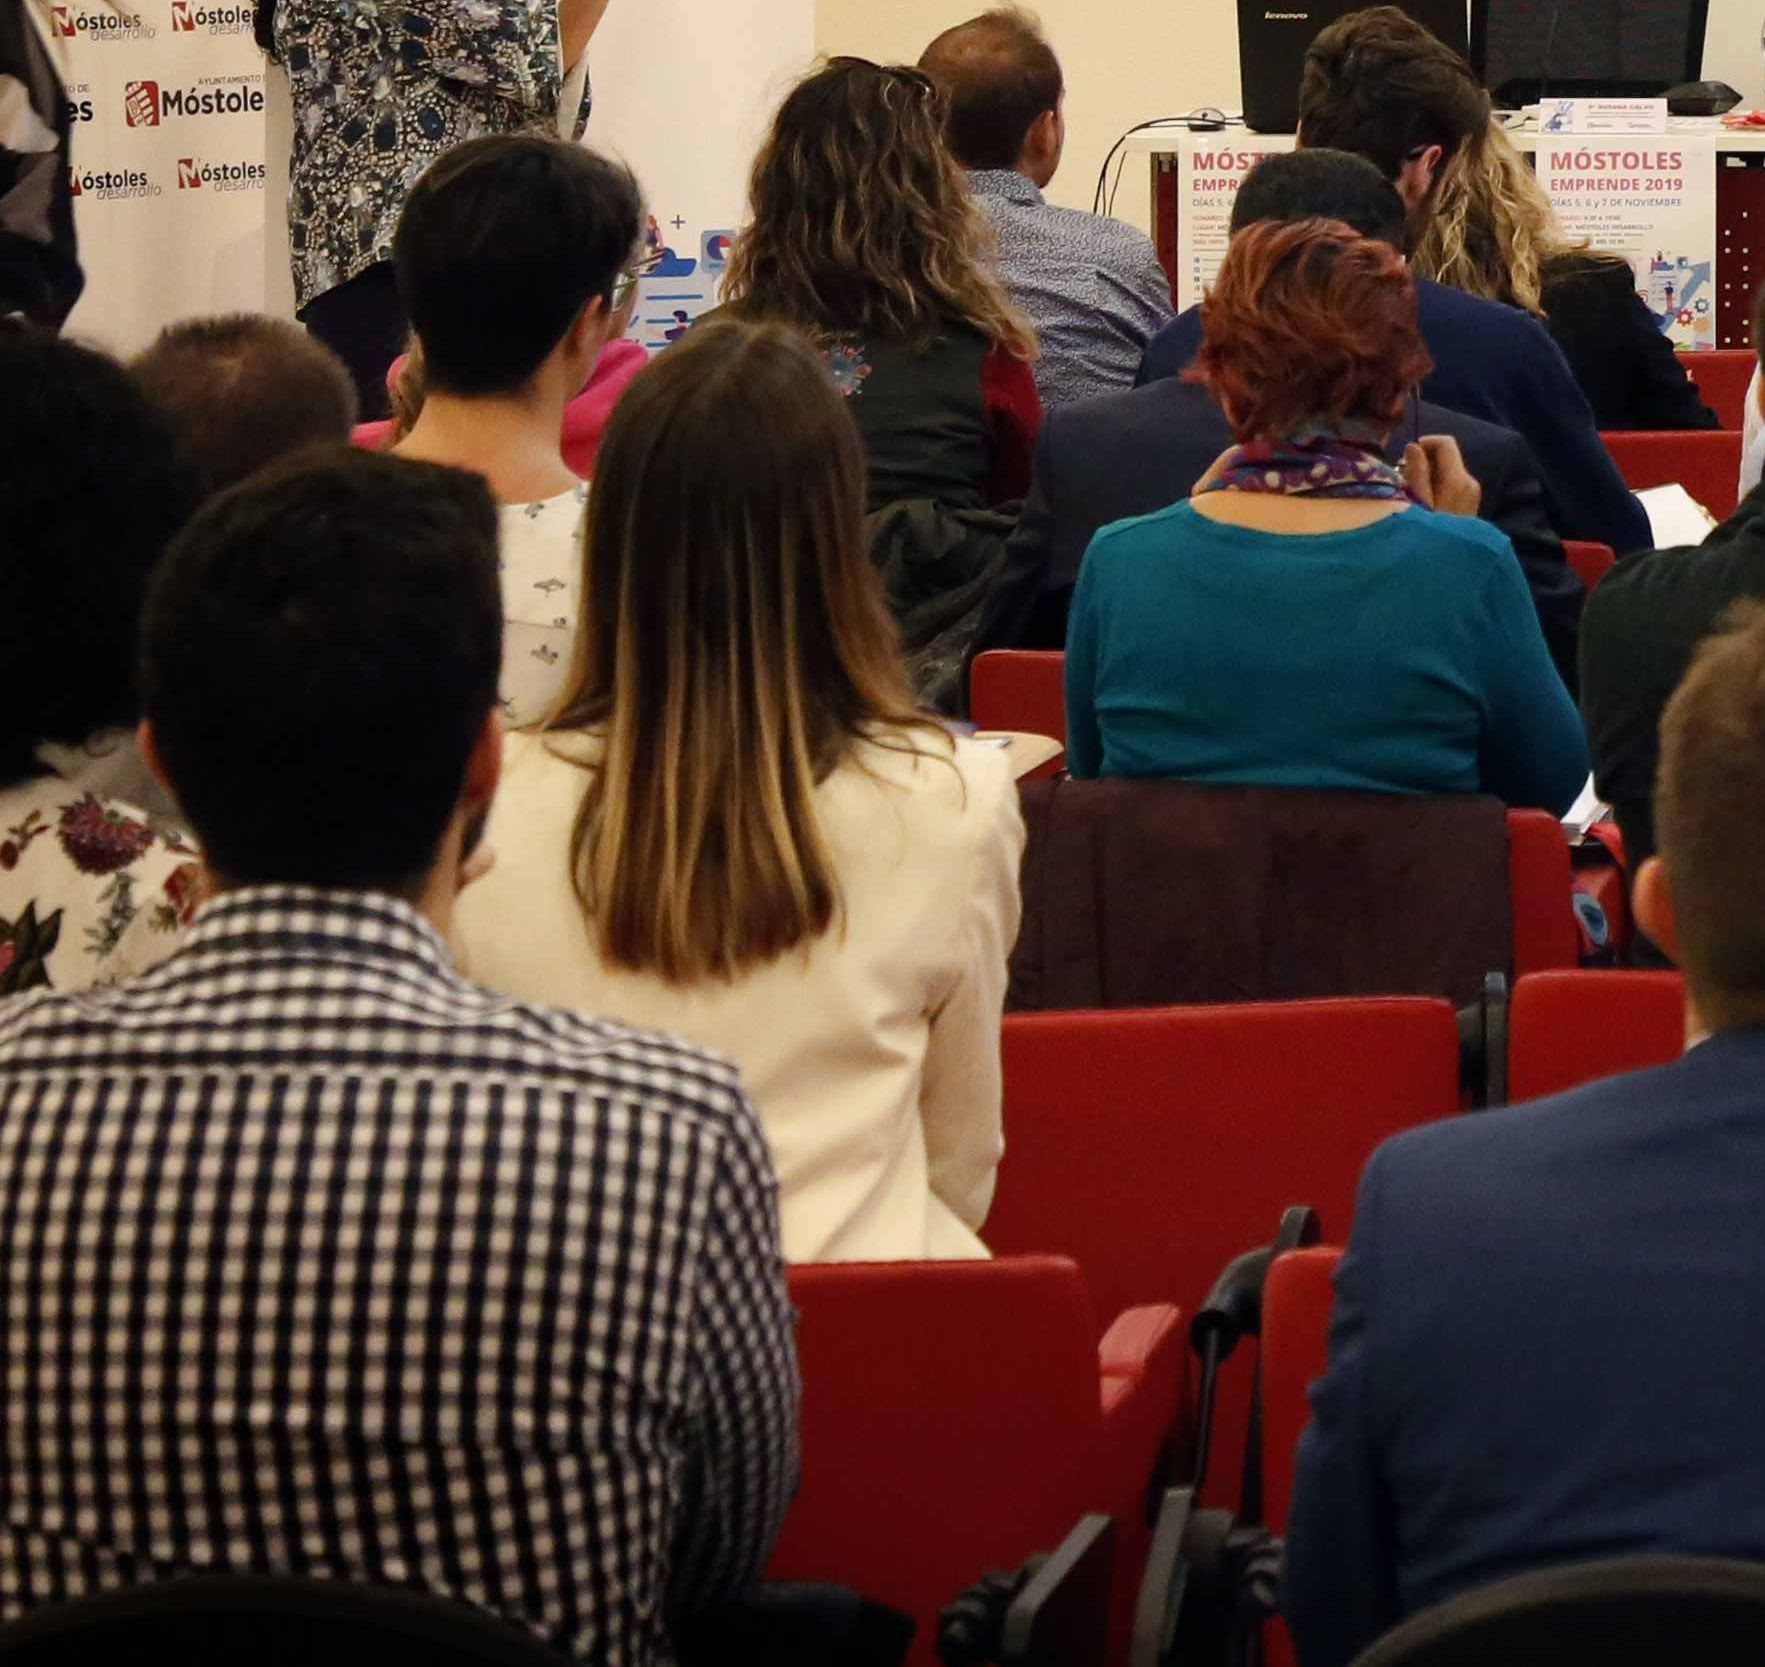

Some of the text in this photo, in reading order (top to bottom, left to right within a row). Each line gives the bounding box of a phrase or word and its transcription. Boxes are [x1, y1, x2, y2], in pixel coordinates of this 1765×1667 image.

[1264, 11, 1308, 19] lenovo
[1551, 147, 1682, 170] MÓSTOLES
[97, 182, 161, 199] desarrollo
[1551, 179, 1683, 191] EMPRENDE 2019
[1551, 197, 1572, 206] DÍAS
